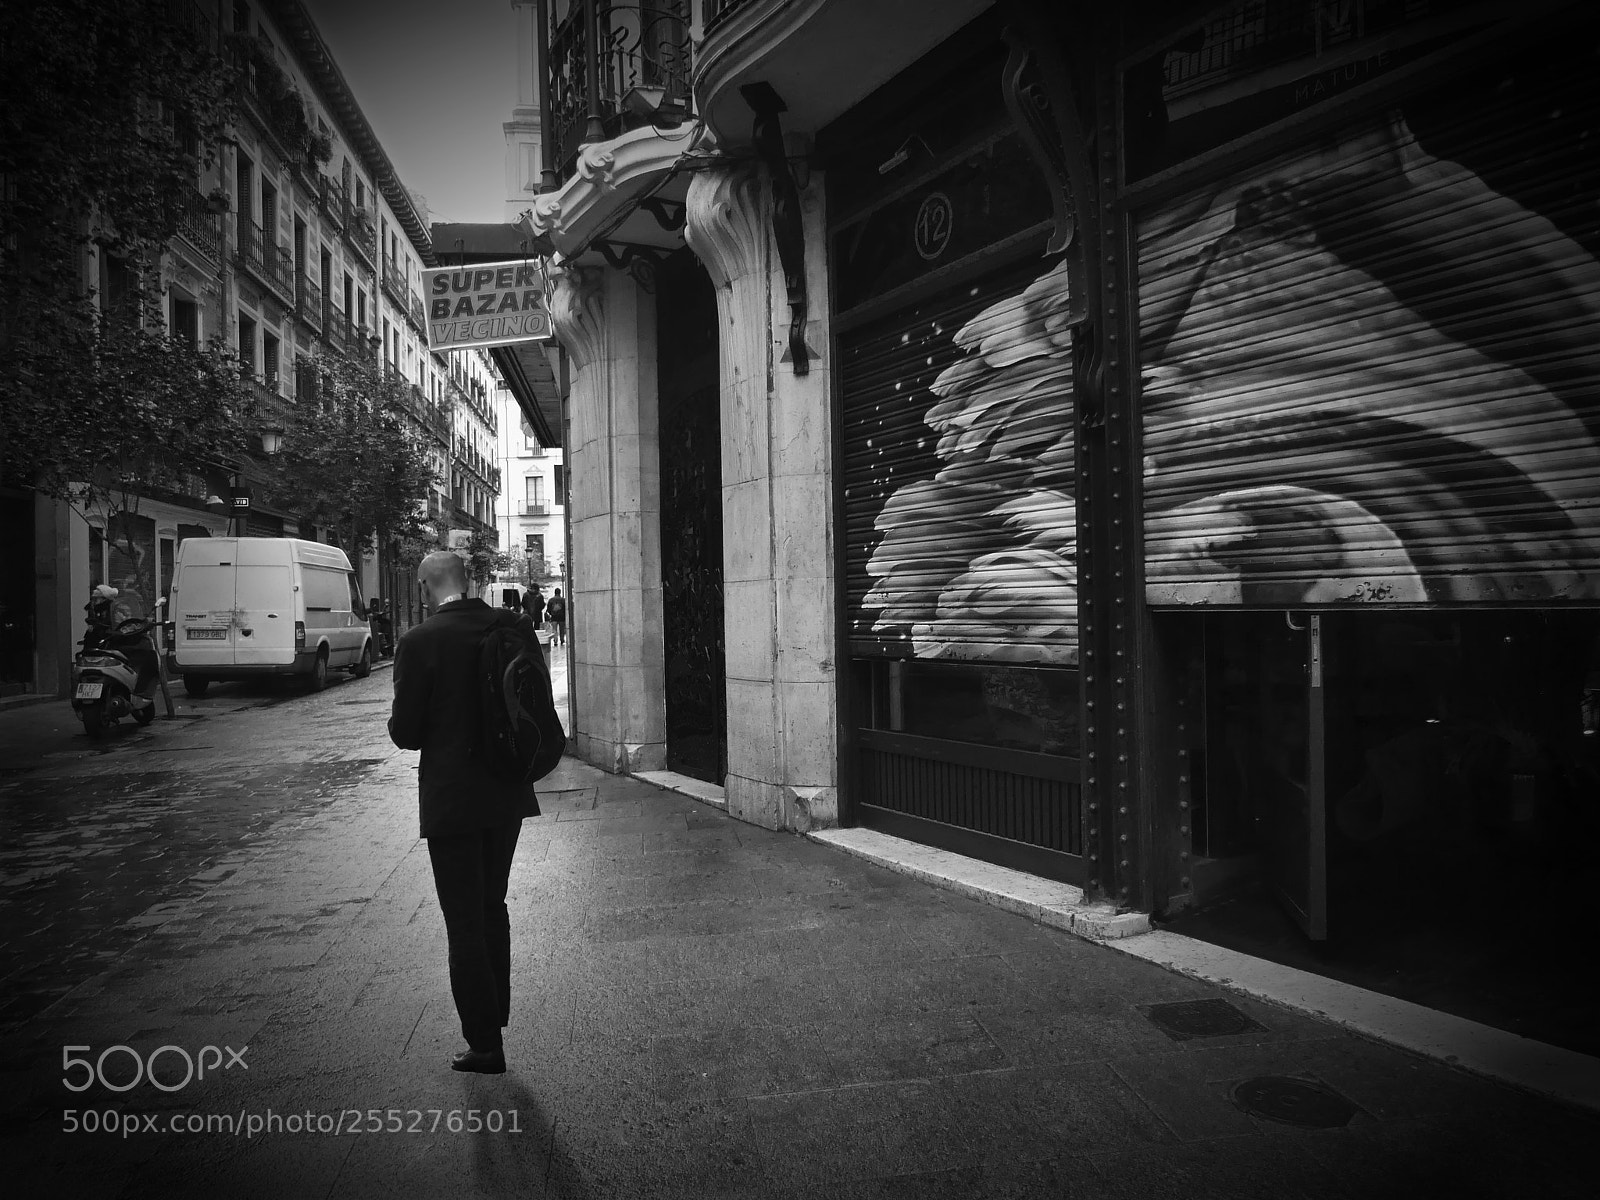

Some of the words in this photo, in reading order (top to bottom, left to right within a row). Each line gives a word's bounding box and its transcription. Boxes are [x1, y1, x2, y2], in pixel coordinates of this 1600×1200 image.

[1295, 51, 1393, 104] MATUTE
[919, 204, 947, 246] 12
[432, 266, 535, 295] SUPER
[431, 289, 542, 320] BAZAR
[432, 313, 546, 344] VECINO
